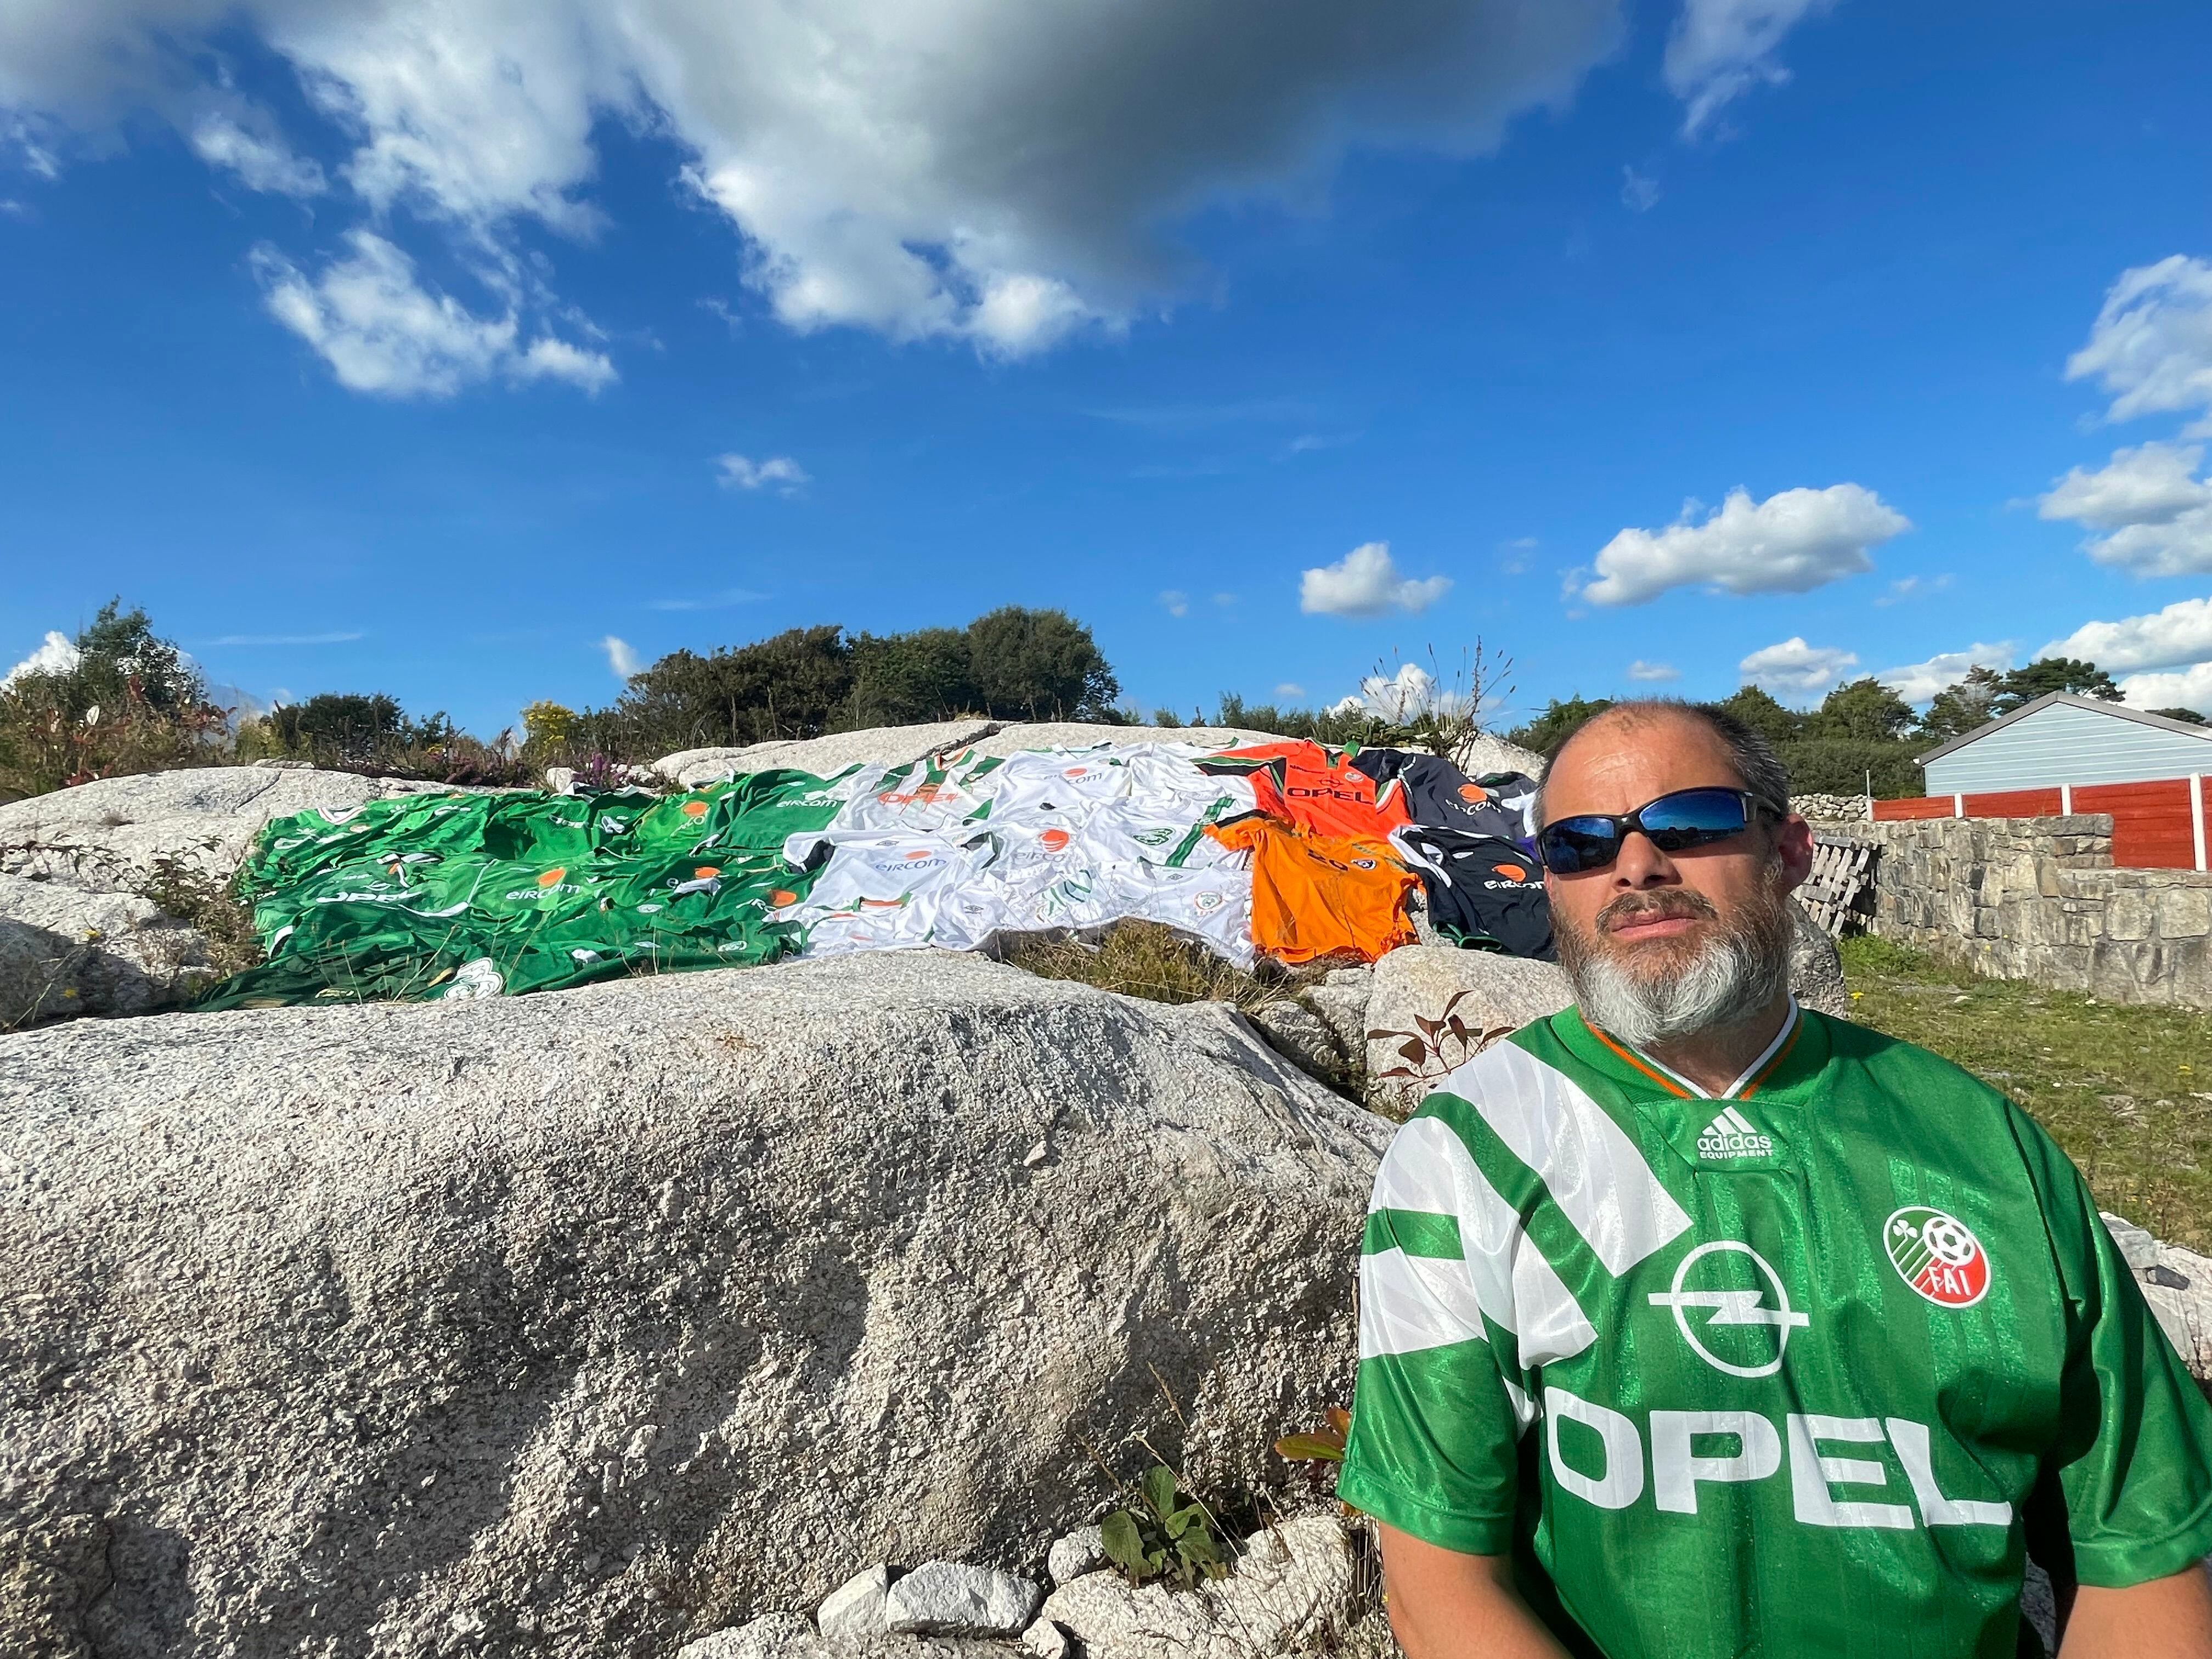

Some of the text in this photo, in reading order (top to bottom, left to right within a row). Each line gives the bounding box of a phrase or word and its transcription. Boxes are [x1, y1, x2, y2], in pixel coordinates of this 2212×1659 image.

[1287, 788, 1374, 805] OPEL
[1697, 1133, 1773, 1152] adidas
[1700, 1149, 1774, 1160] EQUIPMENT
[1927, 1266, 1972, 1296] FAI
[1543, 1385, 2013, 1530] OPEL
